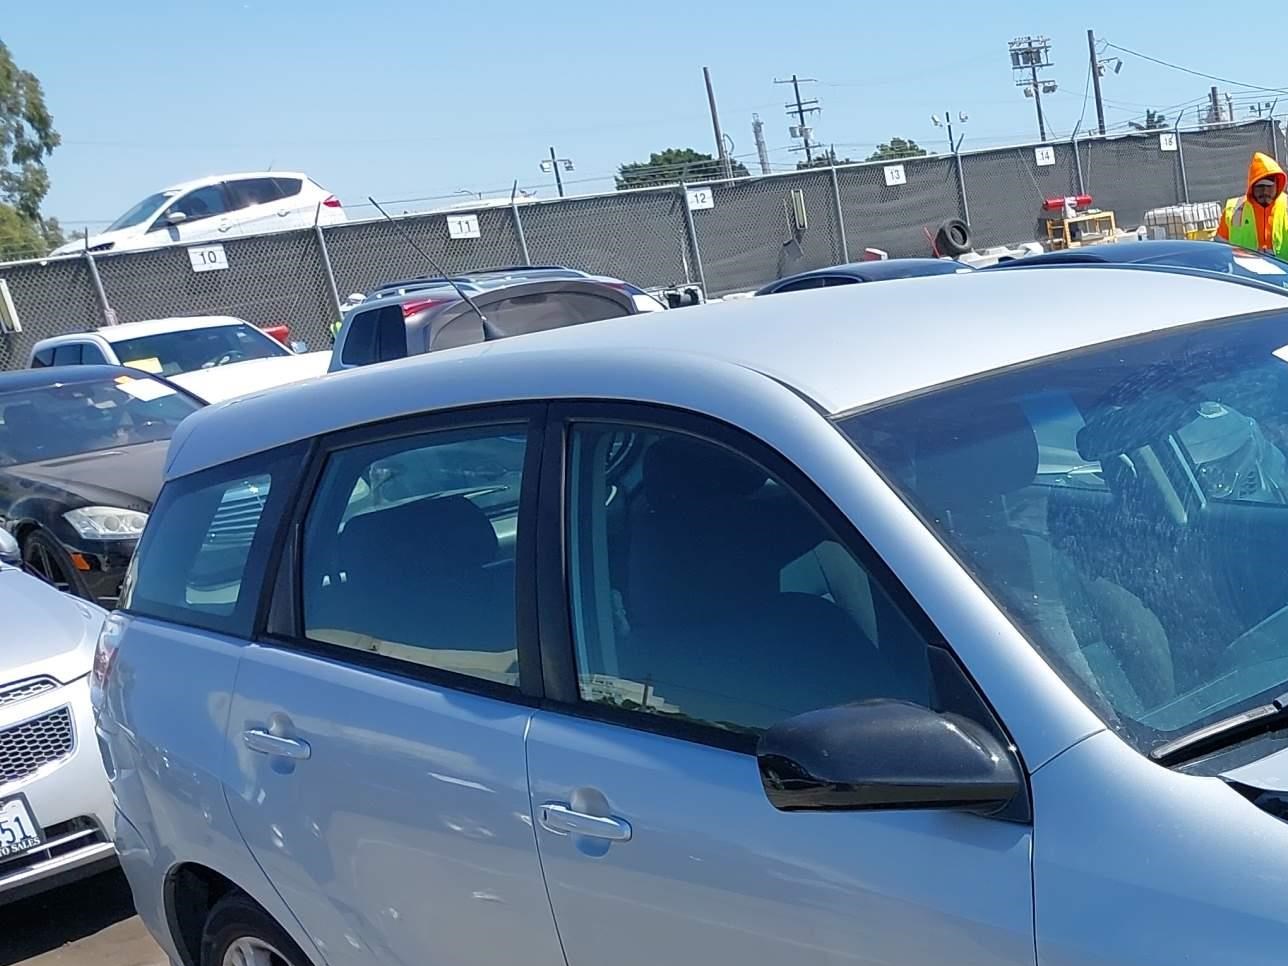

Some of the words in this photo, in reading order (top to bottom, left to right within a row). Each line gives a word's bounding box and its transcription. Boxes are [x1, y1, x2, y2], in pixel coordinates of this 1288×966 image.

[1040, 151, 1050, 161] 14
[890, 170, 900, 180] 13
[694, 193, 706, 204] 12
[458, 220, 471, 232] 11
[200, 250, 217, 265] 10
[11, 836, 40, 852] SALES
